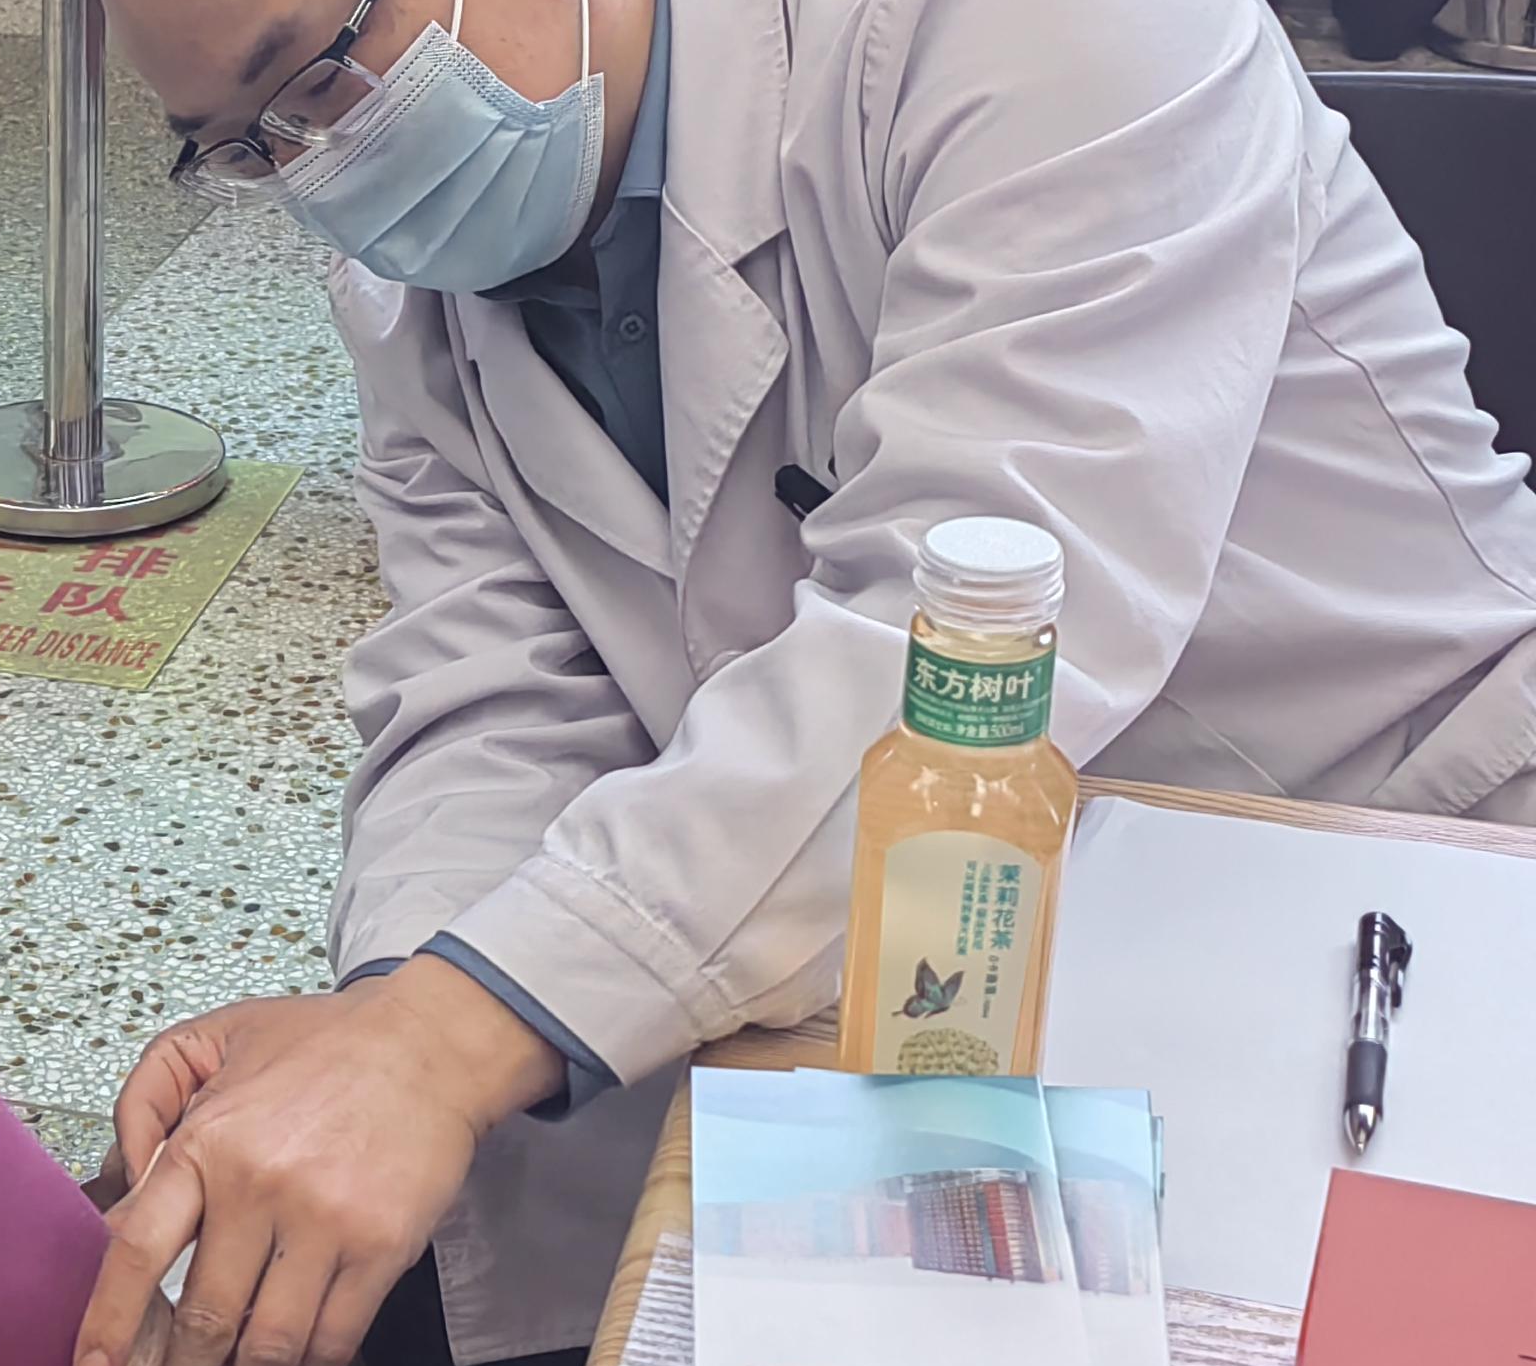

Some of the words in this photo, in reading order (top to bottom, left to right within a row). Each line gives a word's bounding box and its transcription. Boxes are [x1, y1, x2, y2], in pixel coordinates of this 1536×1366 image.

[32, 629, 162, 670] DISTANCE
[914, 656, 1035, 703] 东方树叶
[991, 863, 1022, 950] 茉莉花茶
